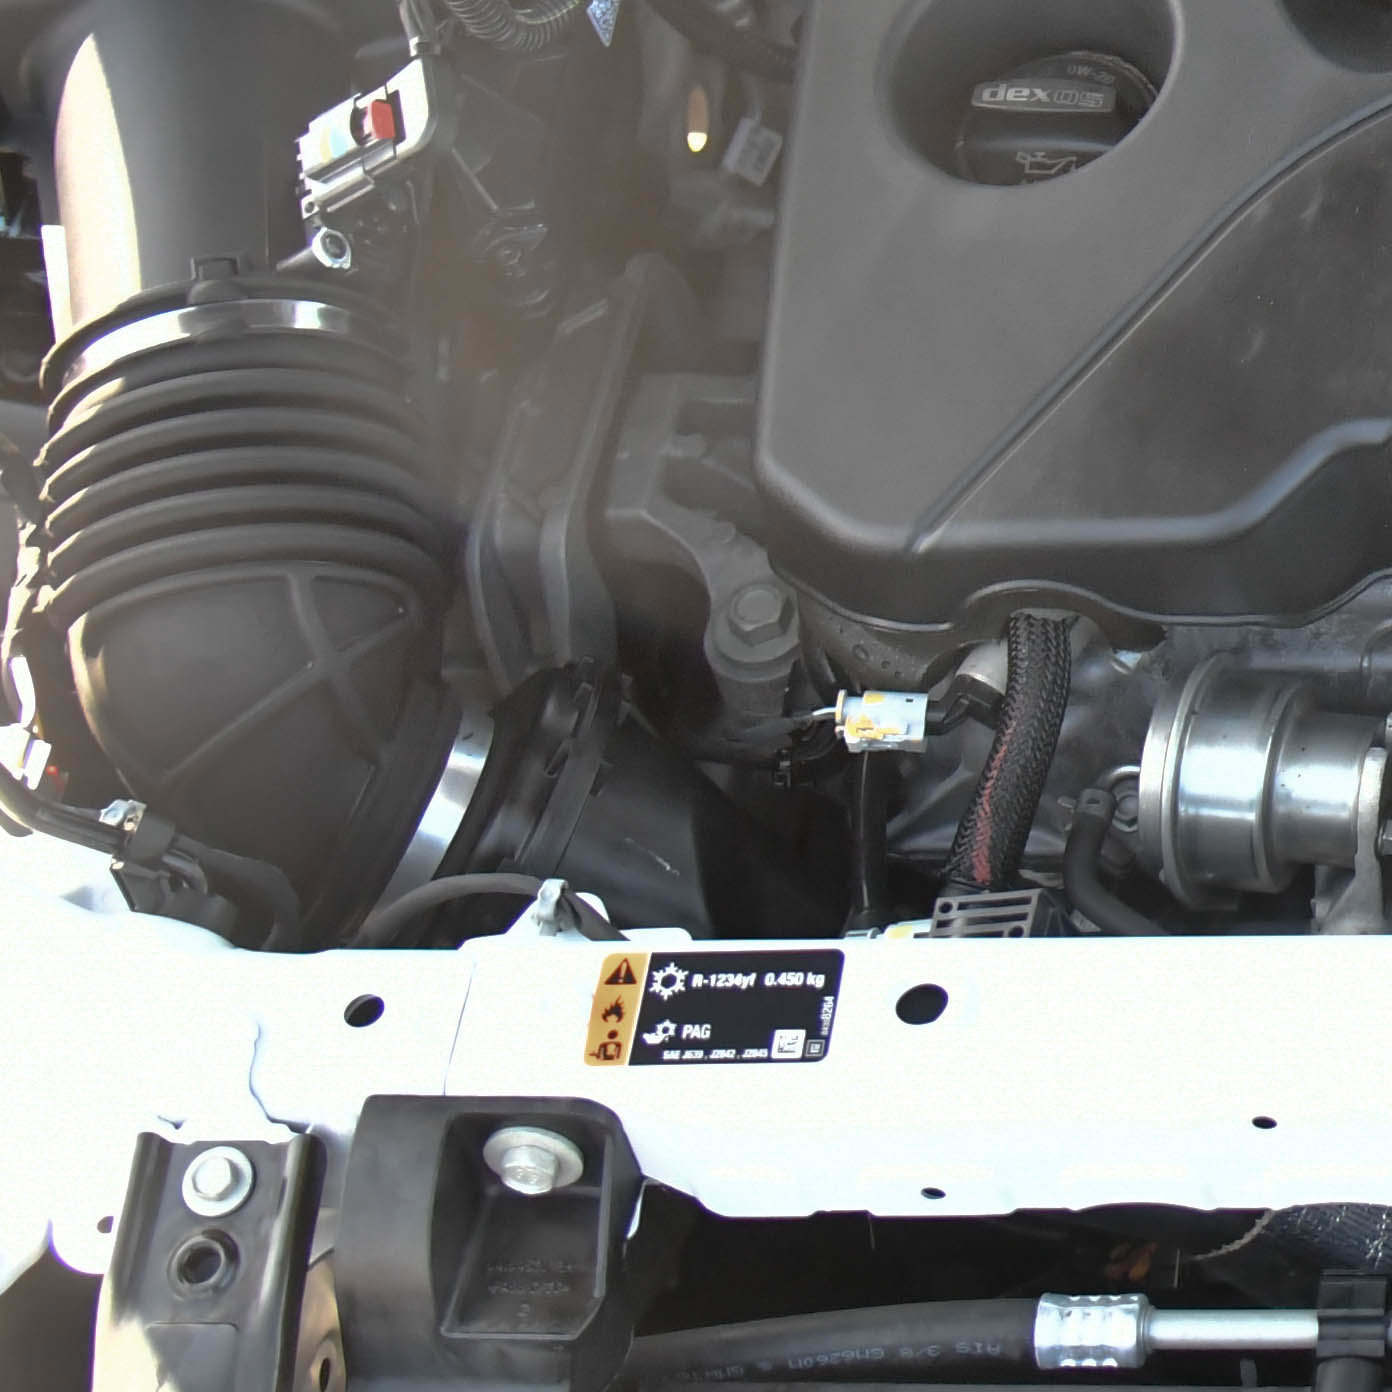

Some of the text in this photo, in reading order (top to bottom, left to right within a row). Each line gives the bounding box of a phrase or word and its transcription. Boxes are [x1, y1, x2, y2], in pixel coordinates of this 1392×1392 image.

[691, 972, 826, 990] R-1234yf 0.450 kg
[681, 1024, 711, 1039] PAG
